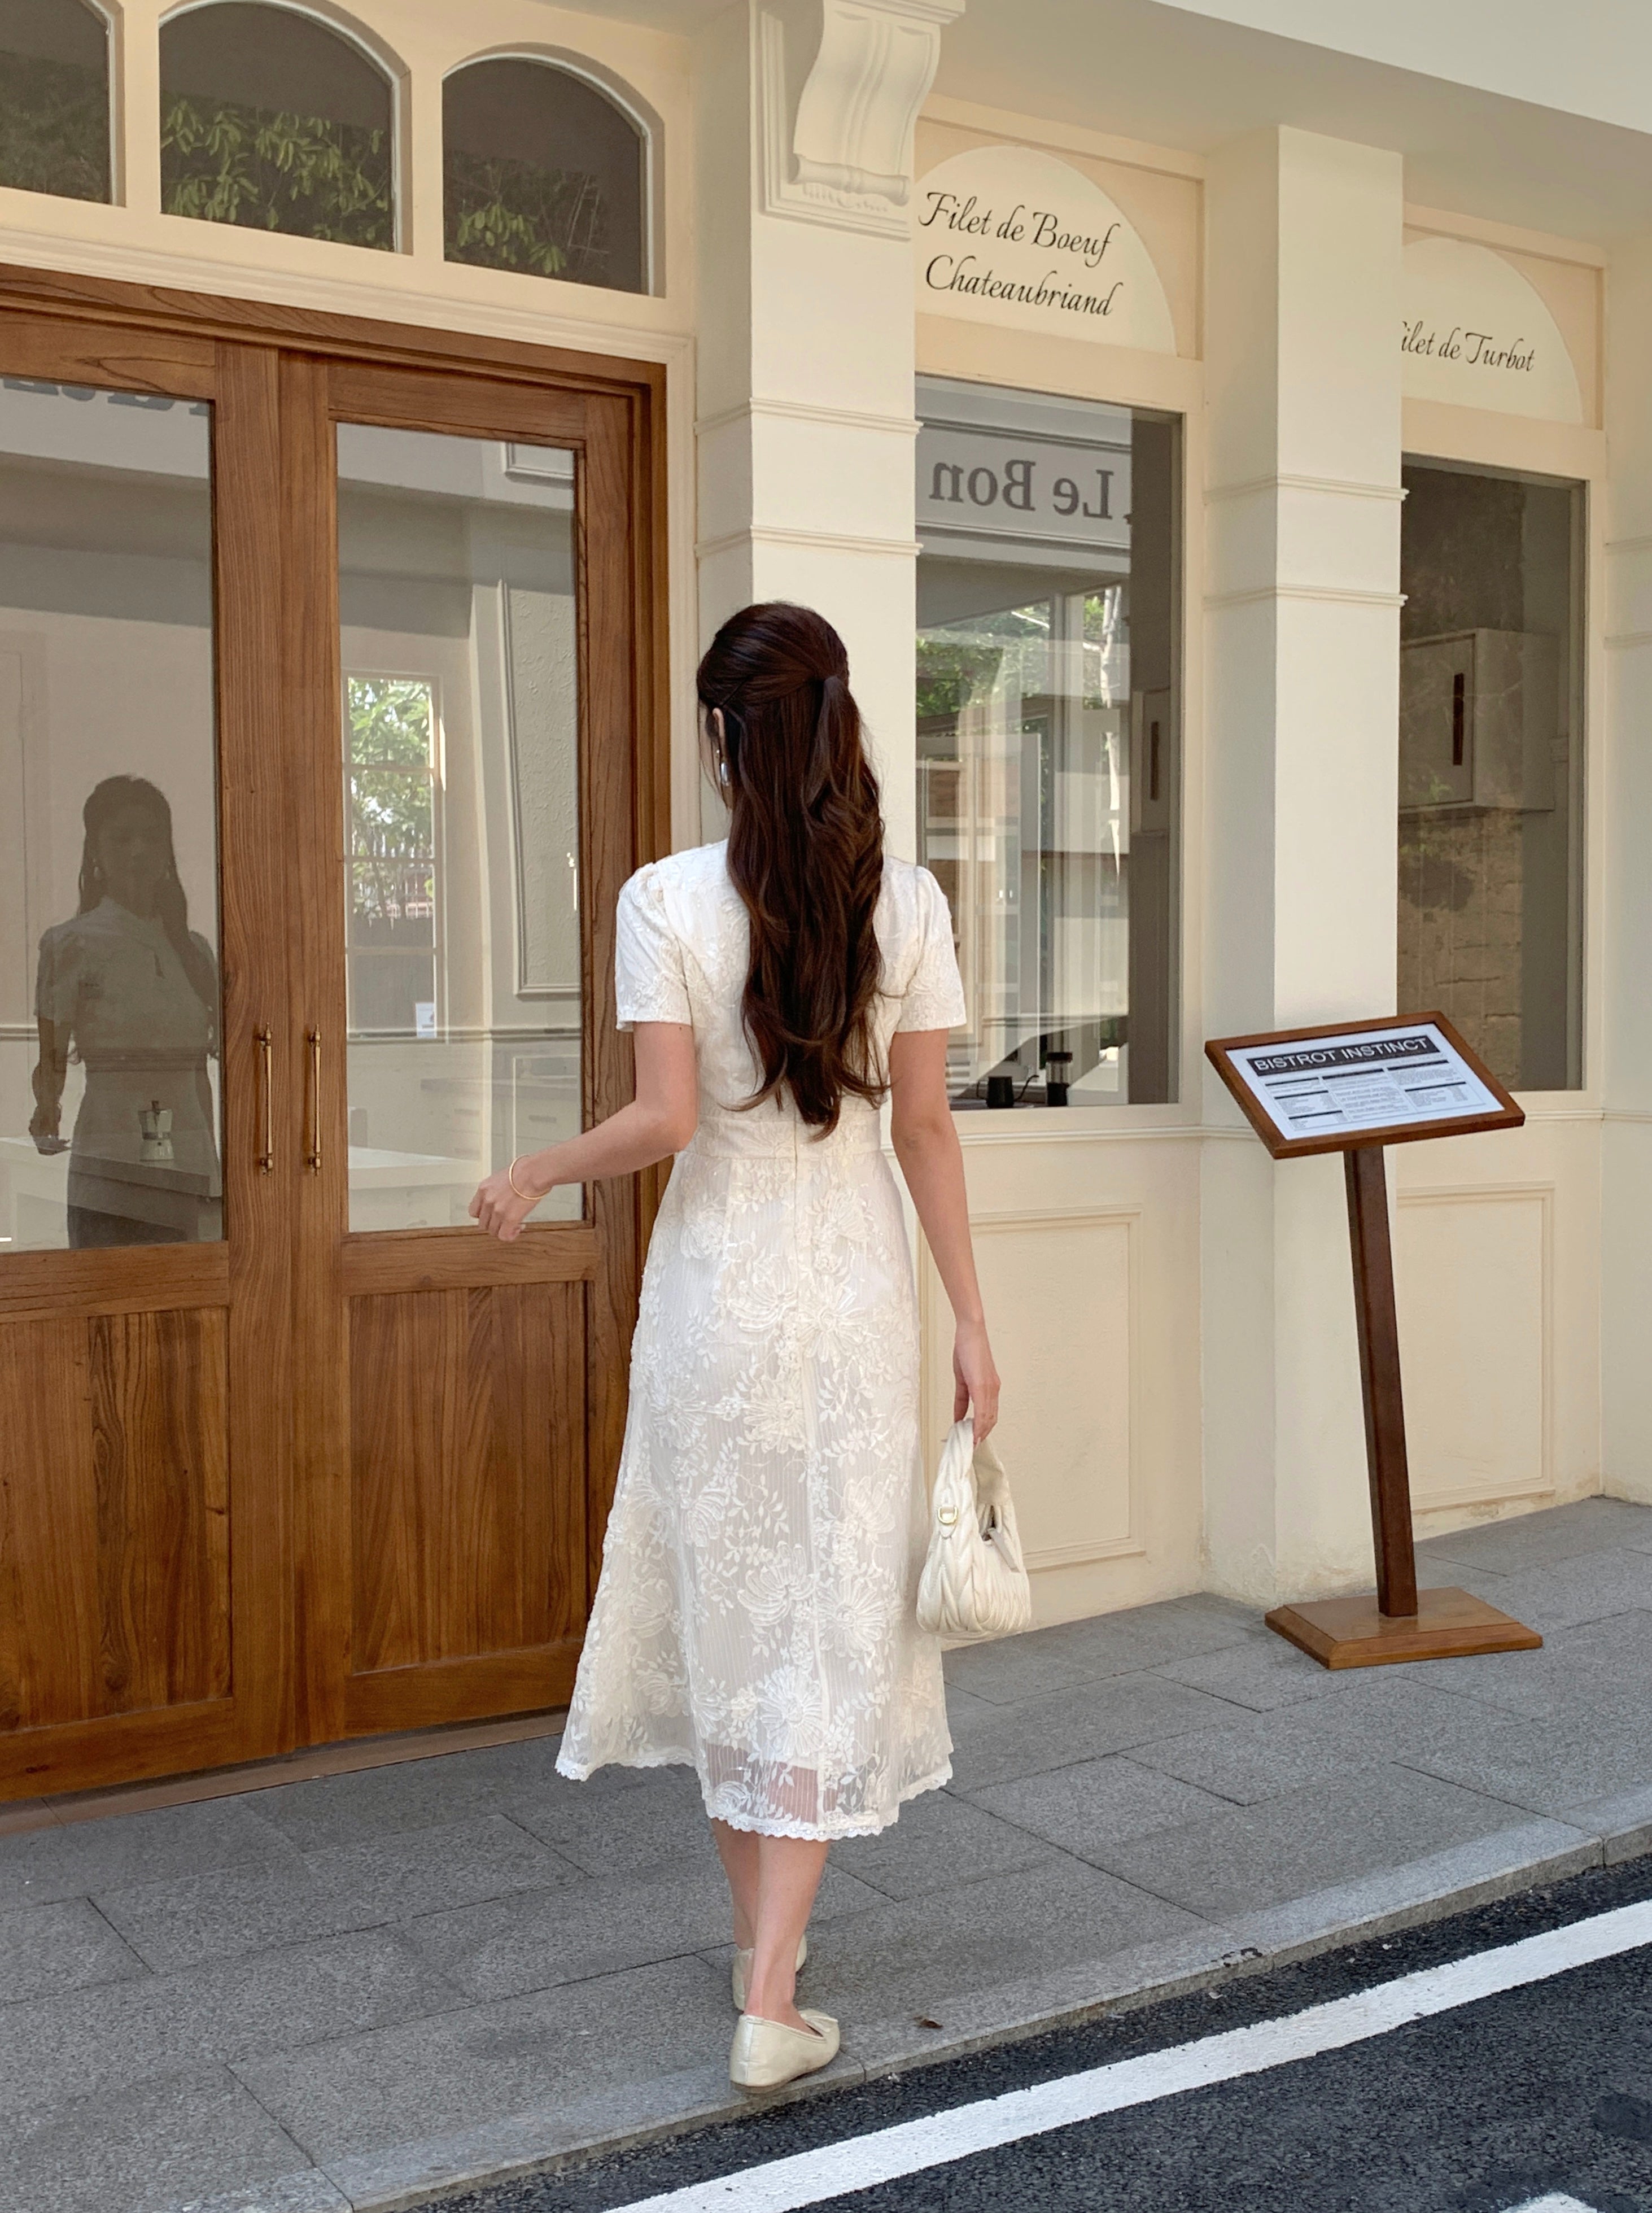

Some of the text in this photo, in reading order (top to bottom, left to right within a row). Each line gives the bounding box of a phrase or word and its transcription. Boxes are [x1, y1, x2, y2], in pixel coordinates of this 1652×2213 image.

[919, 192, 1121, 268] Filet de Boeuf
[925, 254, 1124, 316] Chateaubriand
[1401, 320, 1535, 371] ilet de Turbot
[1254, 1050, 1336, 1071] BISTROT
[1341, 1037, 1428, 1059] INSTINCT
